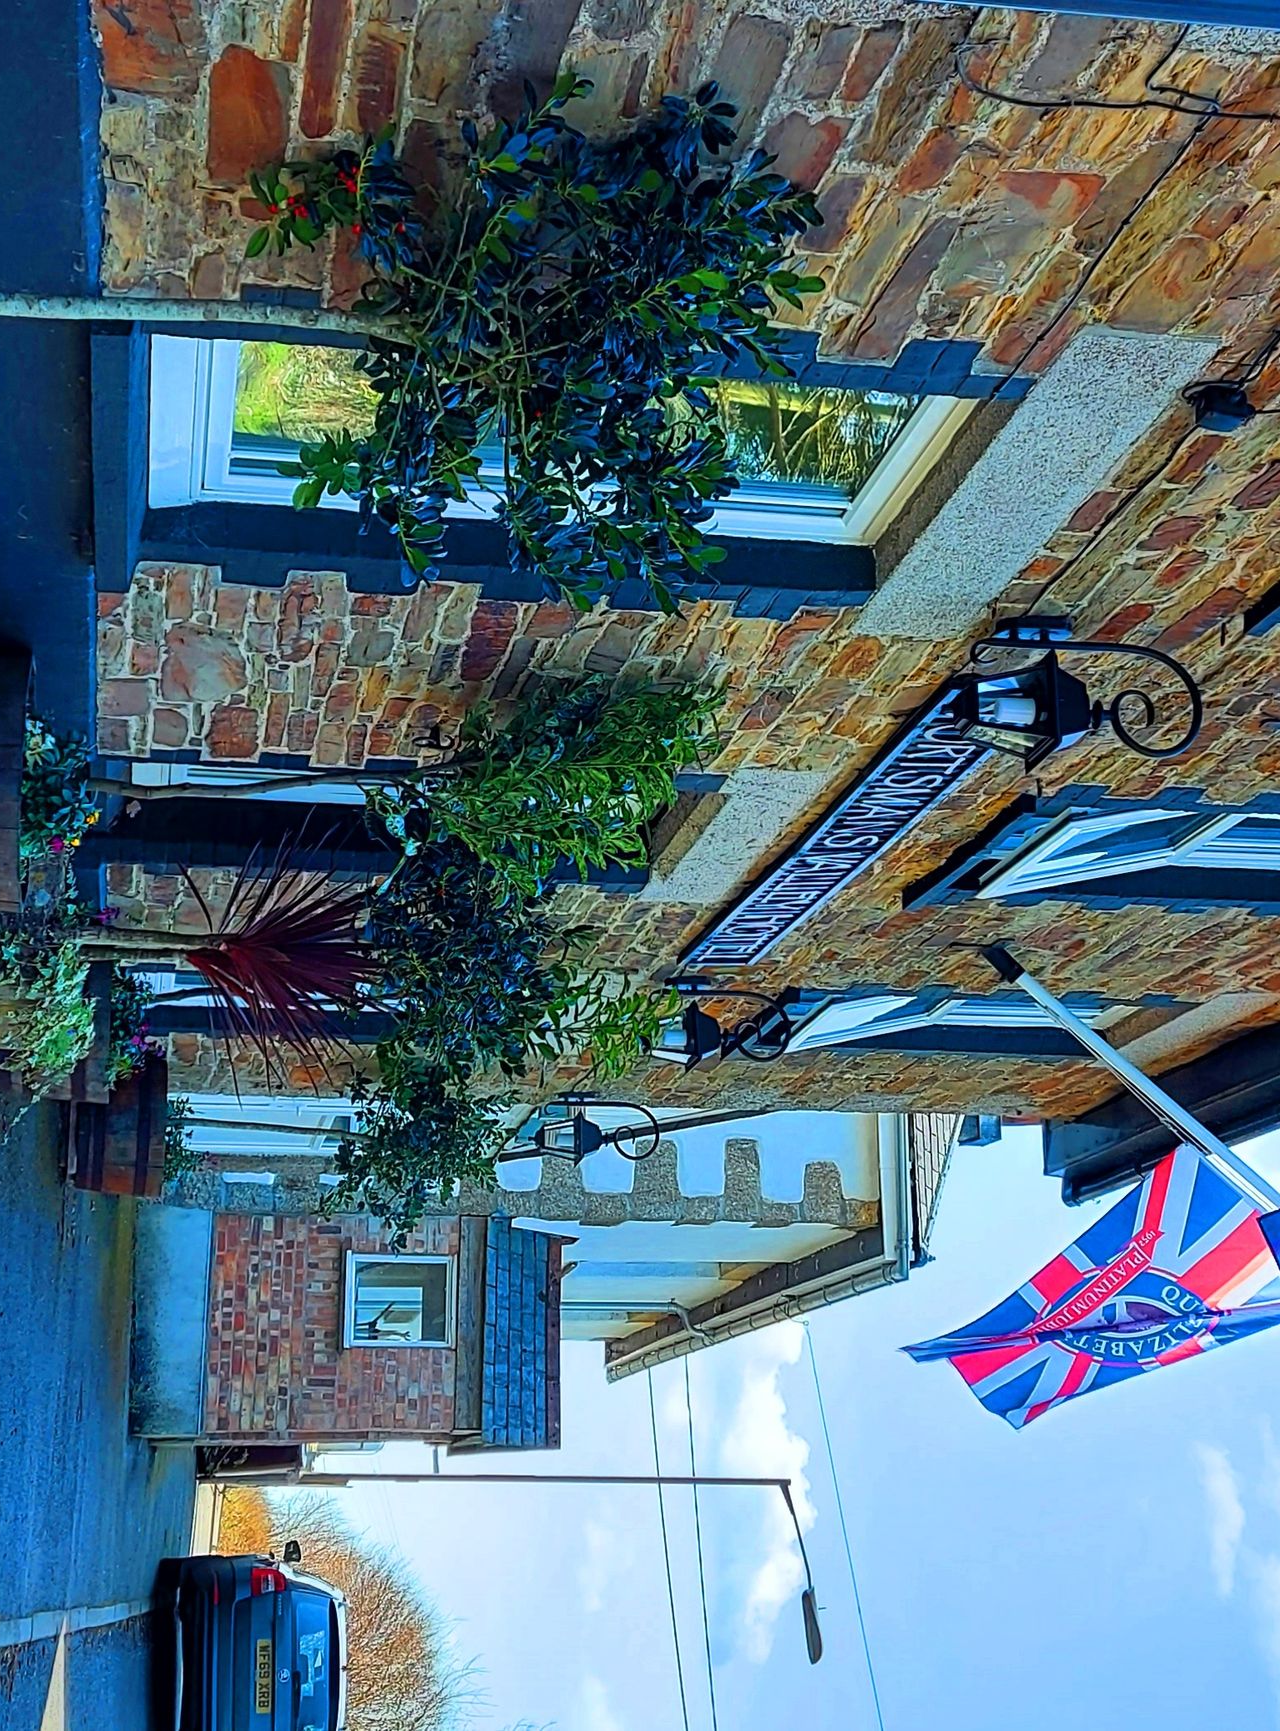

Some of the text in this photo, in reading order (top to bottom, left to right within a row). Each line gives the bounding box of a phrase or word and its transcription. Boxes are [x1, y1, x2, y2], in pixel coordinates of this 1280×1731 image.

[754, 852, 867, 914] VALLEY
[696, 914, 795, 962] HOTEL
[1070, 1251, 1144, 1315] PLATINUM
[258, 1683, 270, 1709] XRB
